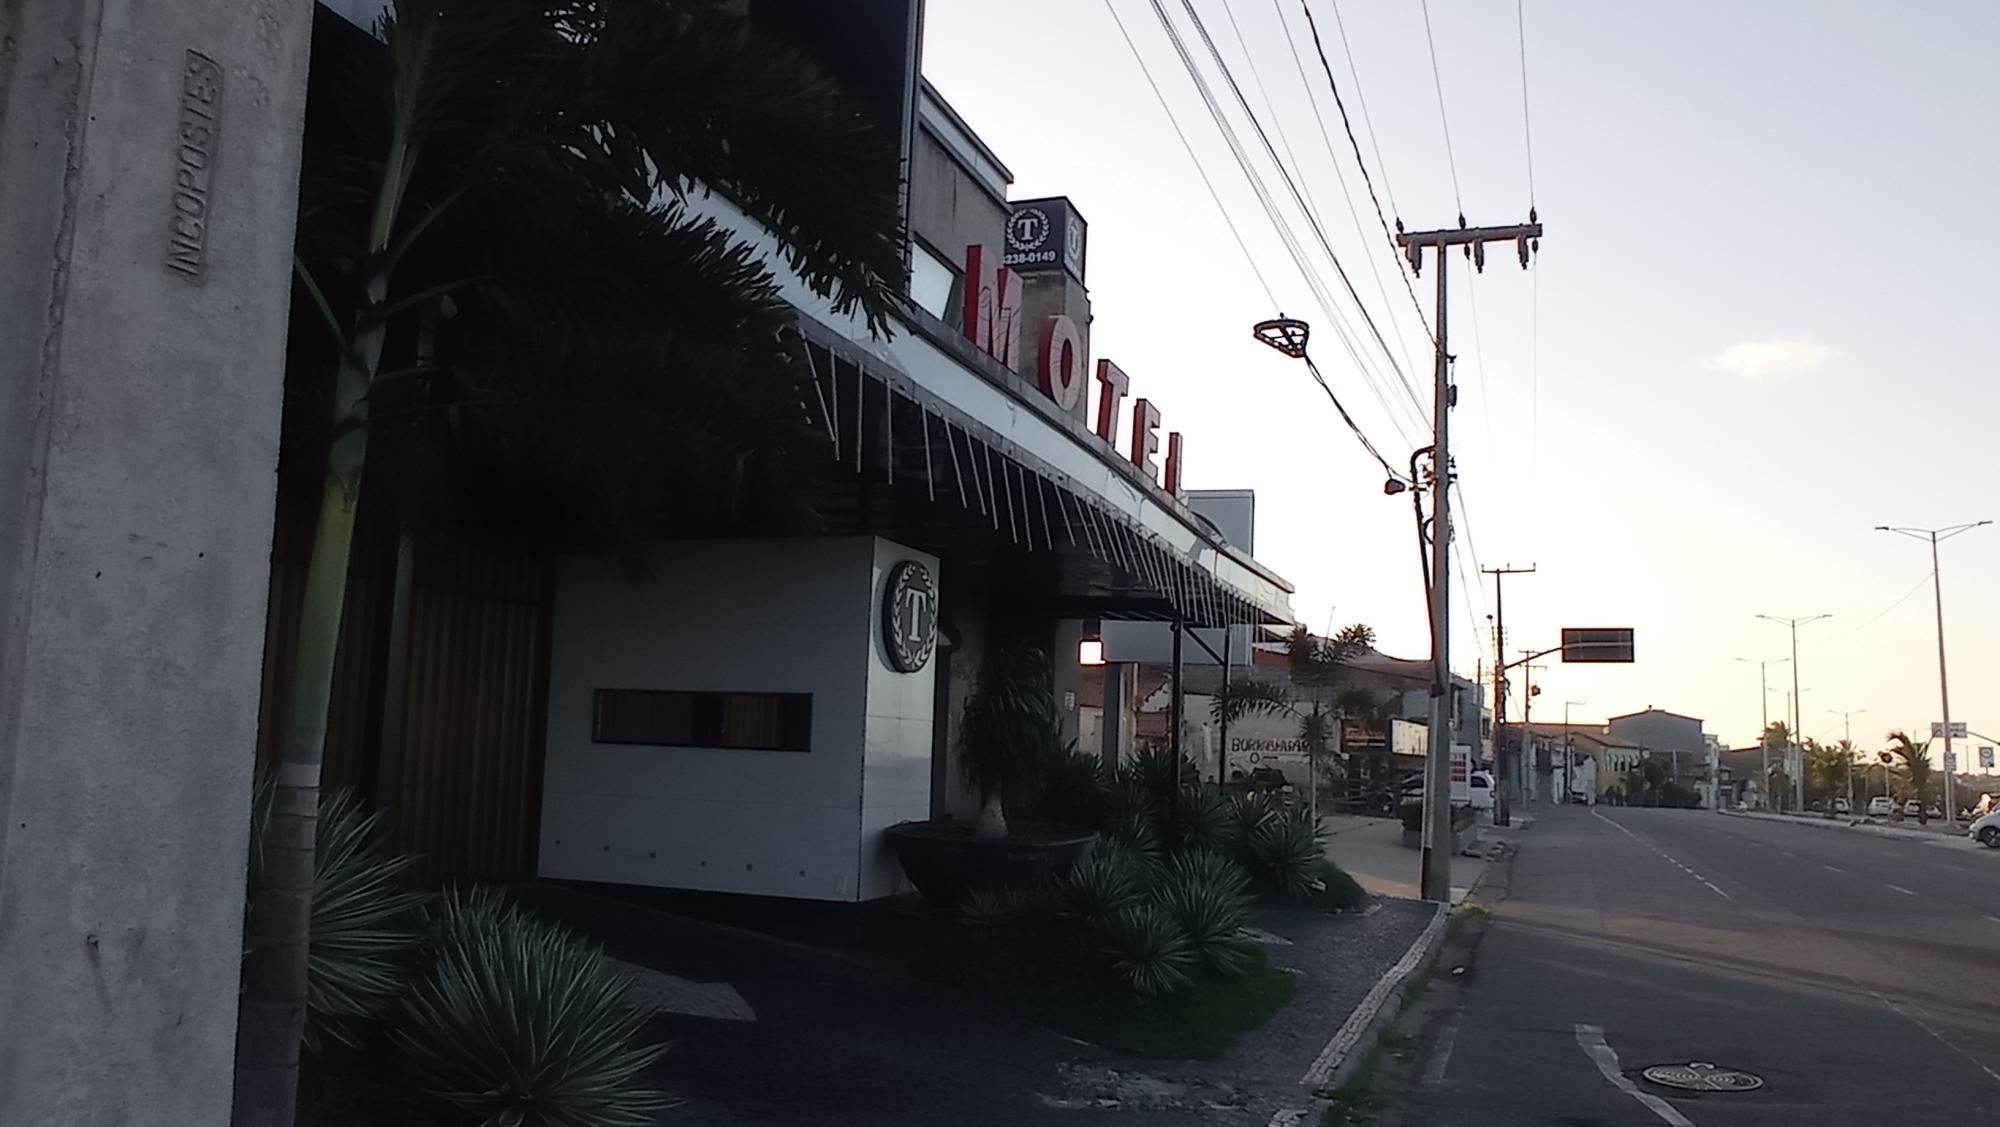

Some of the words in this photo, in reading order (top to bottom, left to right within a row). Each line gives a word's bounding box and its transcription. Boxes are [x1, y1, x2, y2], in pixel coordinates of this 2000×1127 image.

[165, 60, 219, 278] INCOPOSTES
[1017, 218, 1038, 241] T
[1003, 251, 1056, 265] 238-0149
[963, 244, 1188, 508] MOTEL
[904, 587, 927, 642] T
